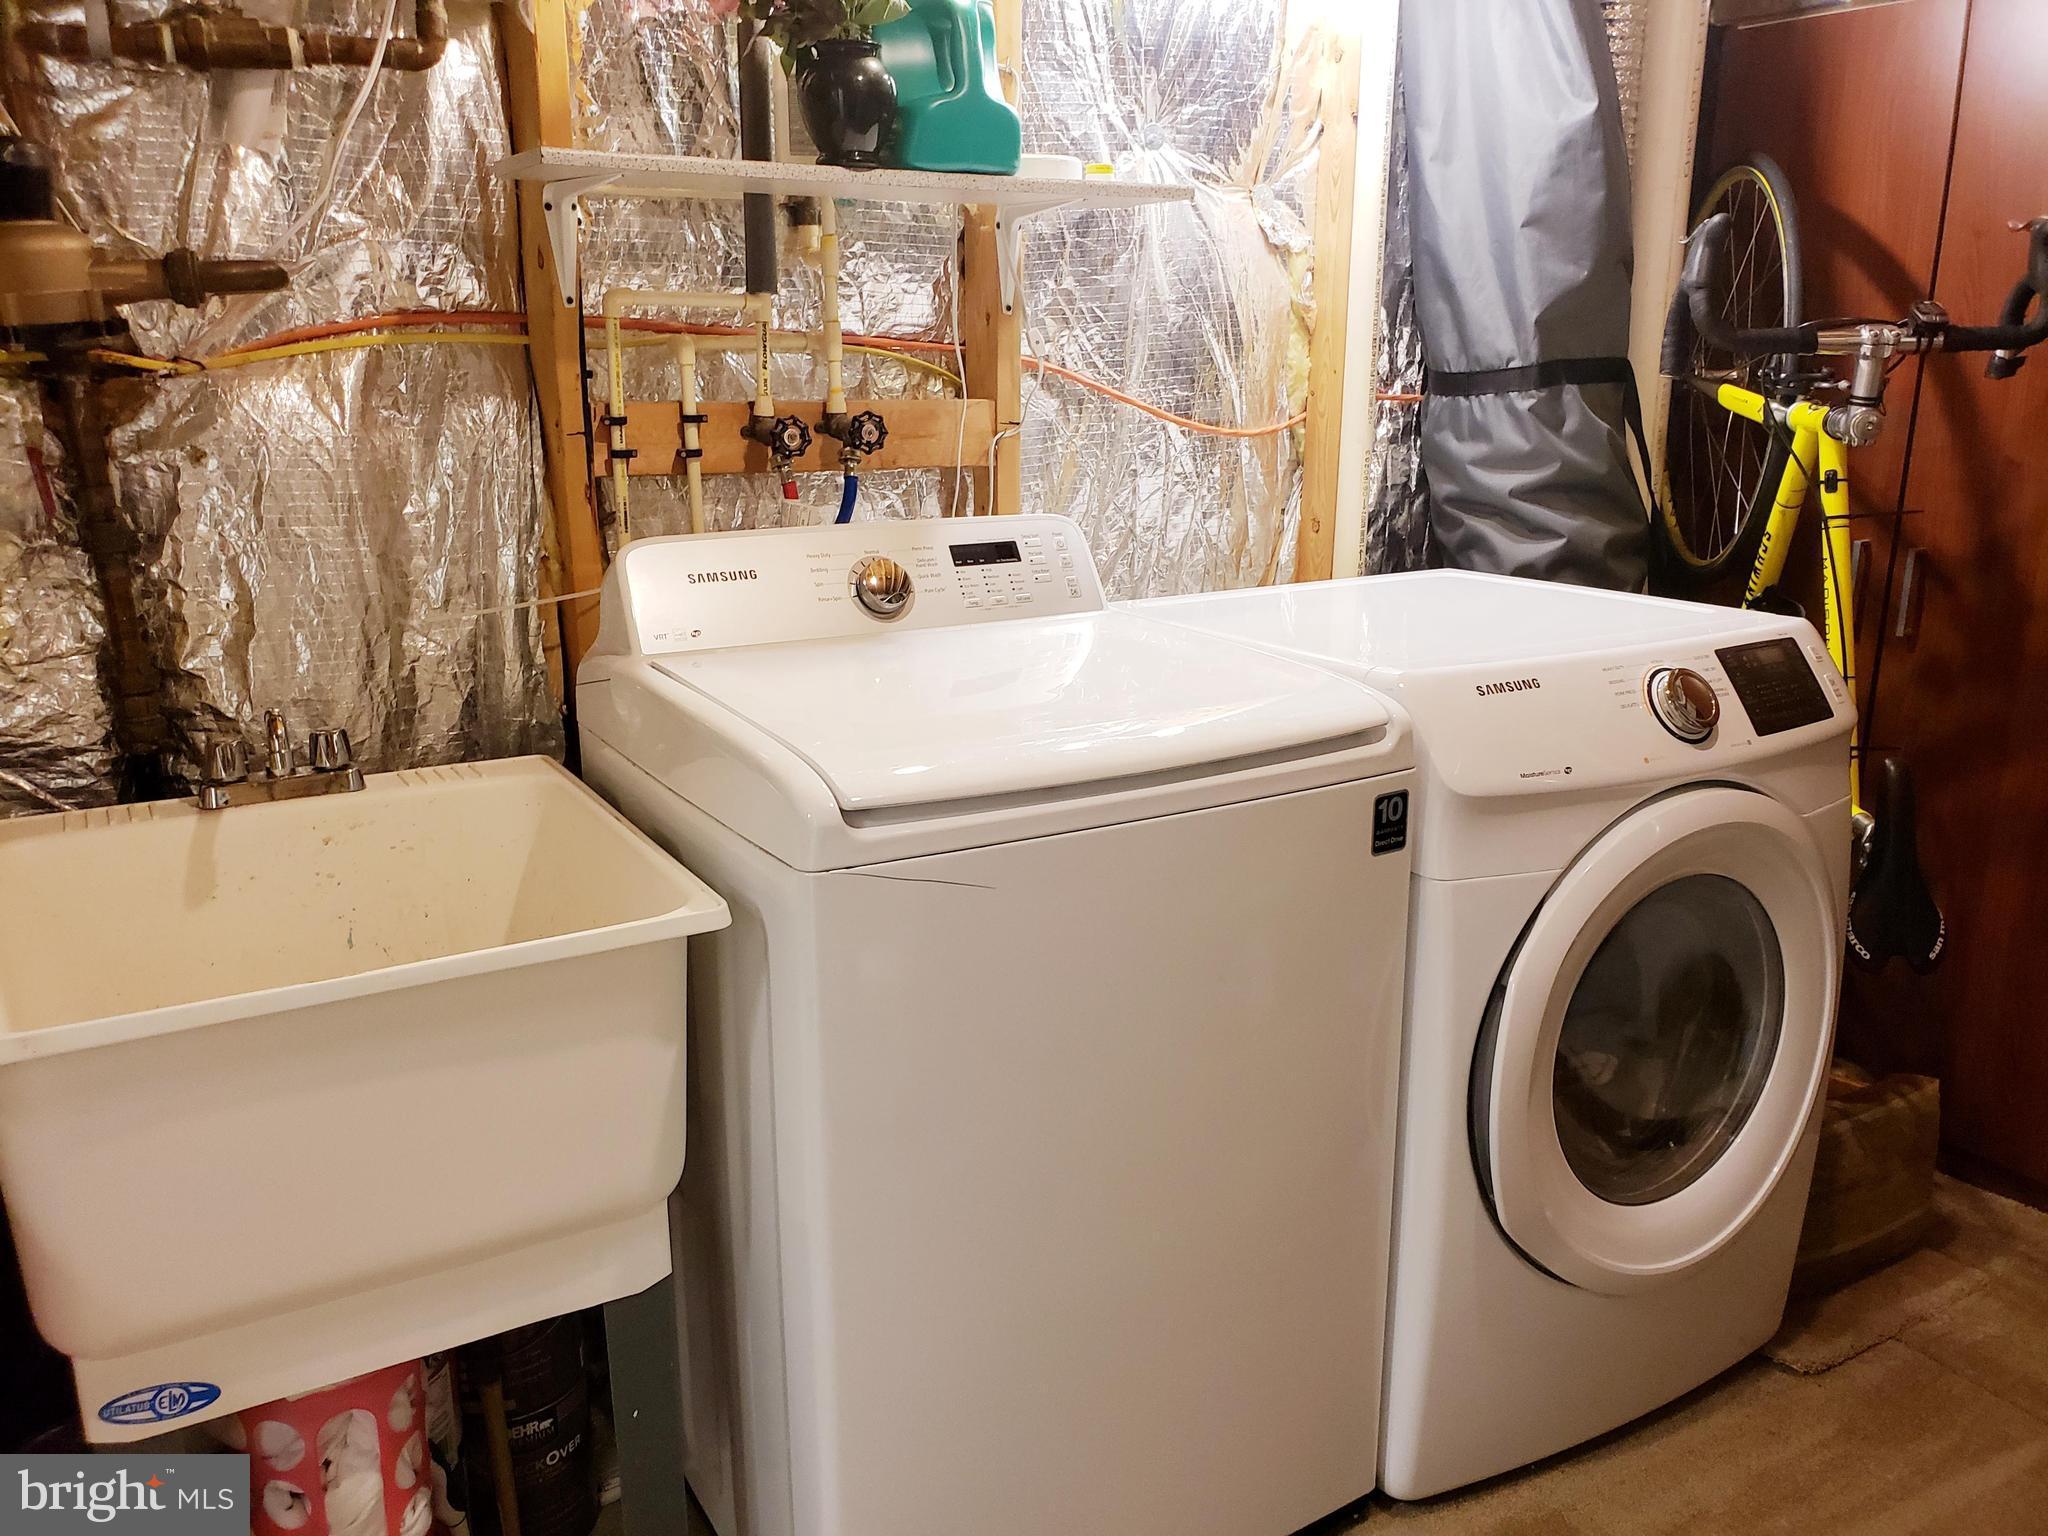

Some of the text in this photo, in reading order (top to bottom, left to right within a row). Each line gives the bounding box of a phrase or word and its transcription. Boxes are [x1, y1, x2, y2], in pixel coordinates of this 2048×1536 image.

[688, 569, 757, 584] SAMSUNG
[1476, 678, 1541, 696] SAMSUNG
[1378, 796, 1403, 824] 10
[1375, 838, 1390, 847] Direct
[512, 1421, 540, 1440] EHR
